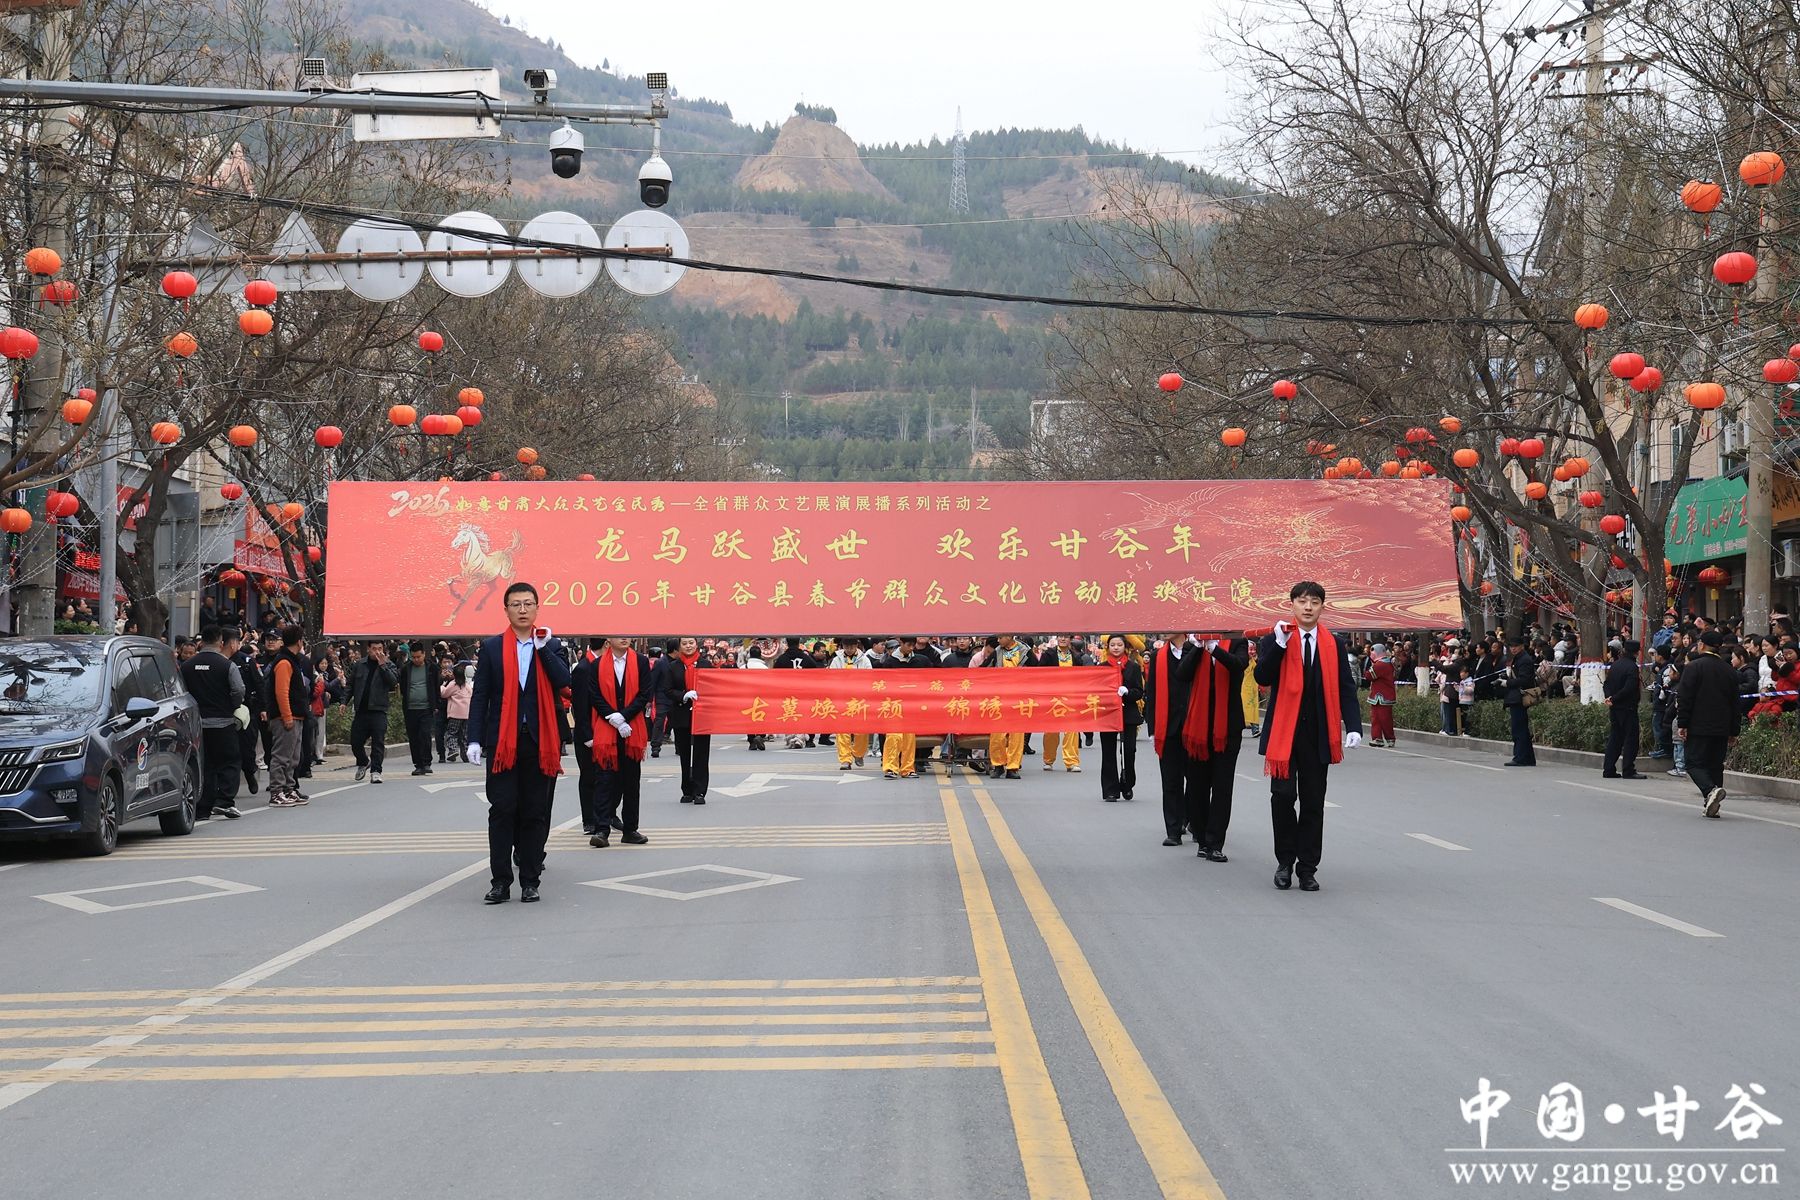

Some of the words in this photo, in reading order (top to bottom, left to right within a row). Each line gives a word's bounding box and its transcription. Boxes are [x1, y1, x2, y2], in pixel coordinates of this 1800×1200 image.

[387, 485, 451, 517] 2026
[595, 526, 869, 566] 龙马跃盛世
[936, 523, 1202, 564] 欢乐甘谷年
[542, 577, 1253, 609] 2026年甘谷县春节群众文化活动联欢汇演
[871, 679, 975, 693] 第一篇章
